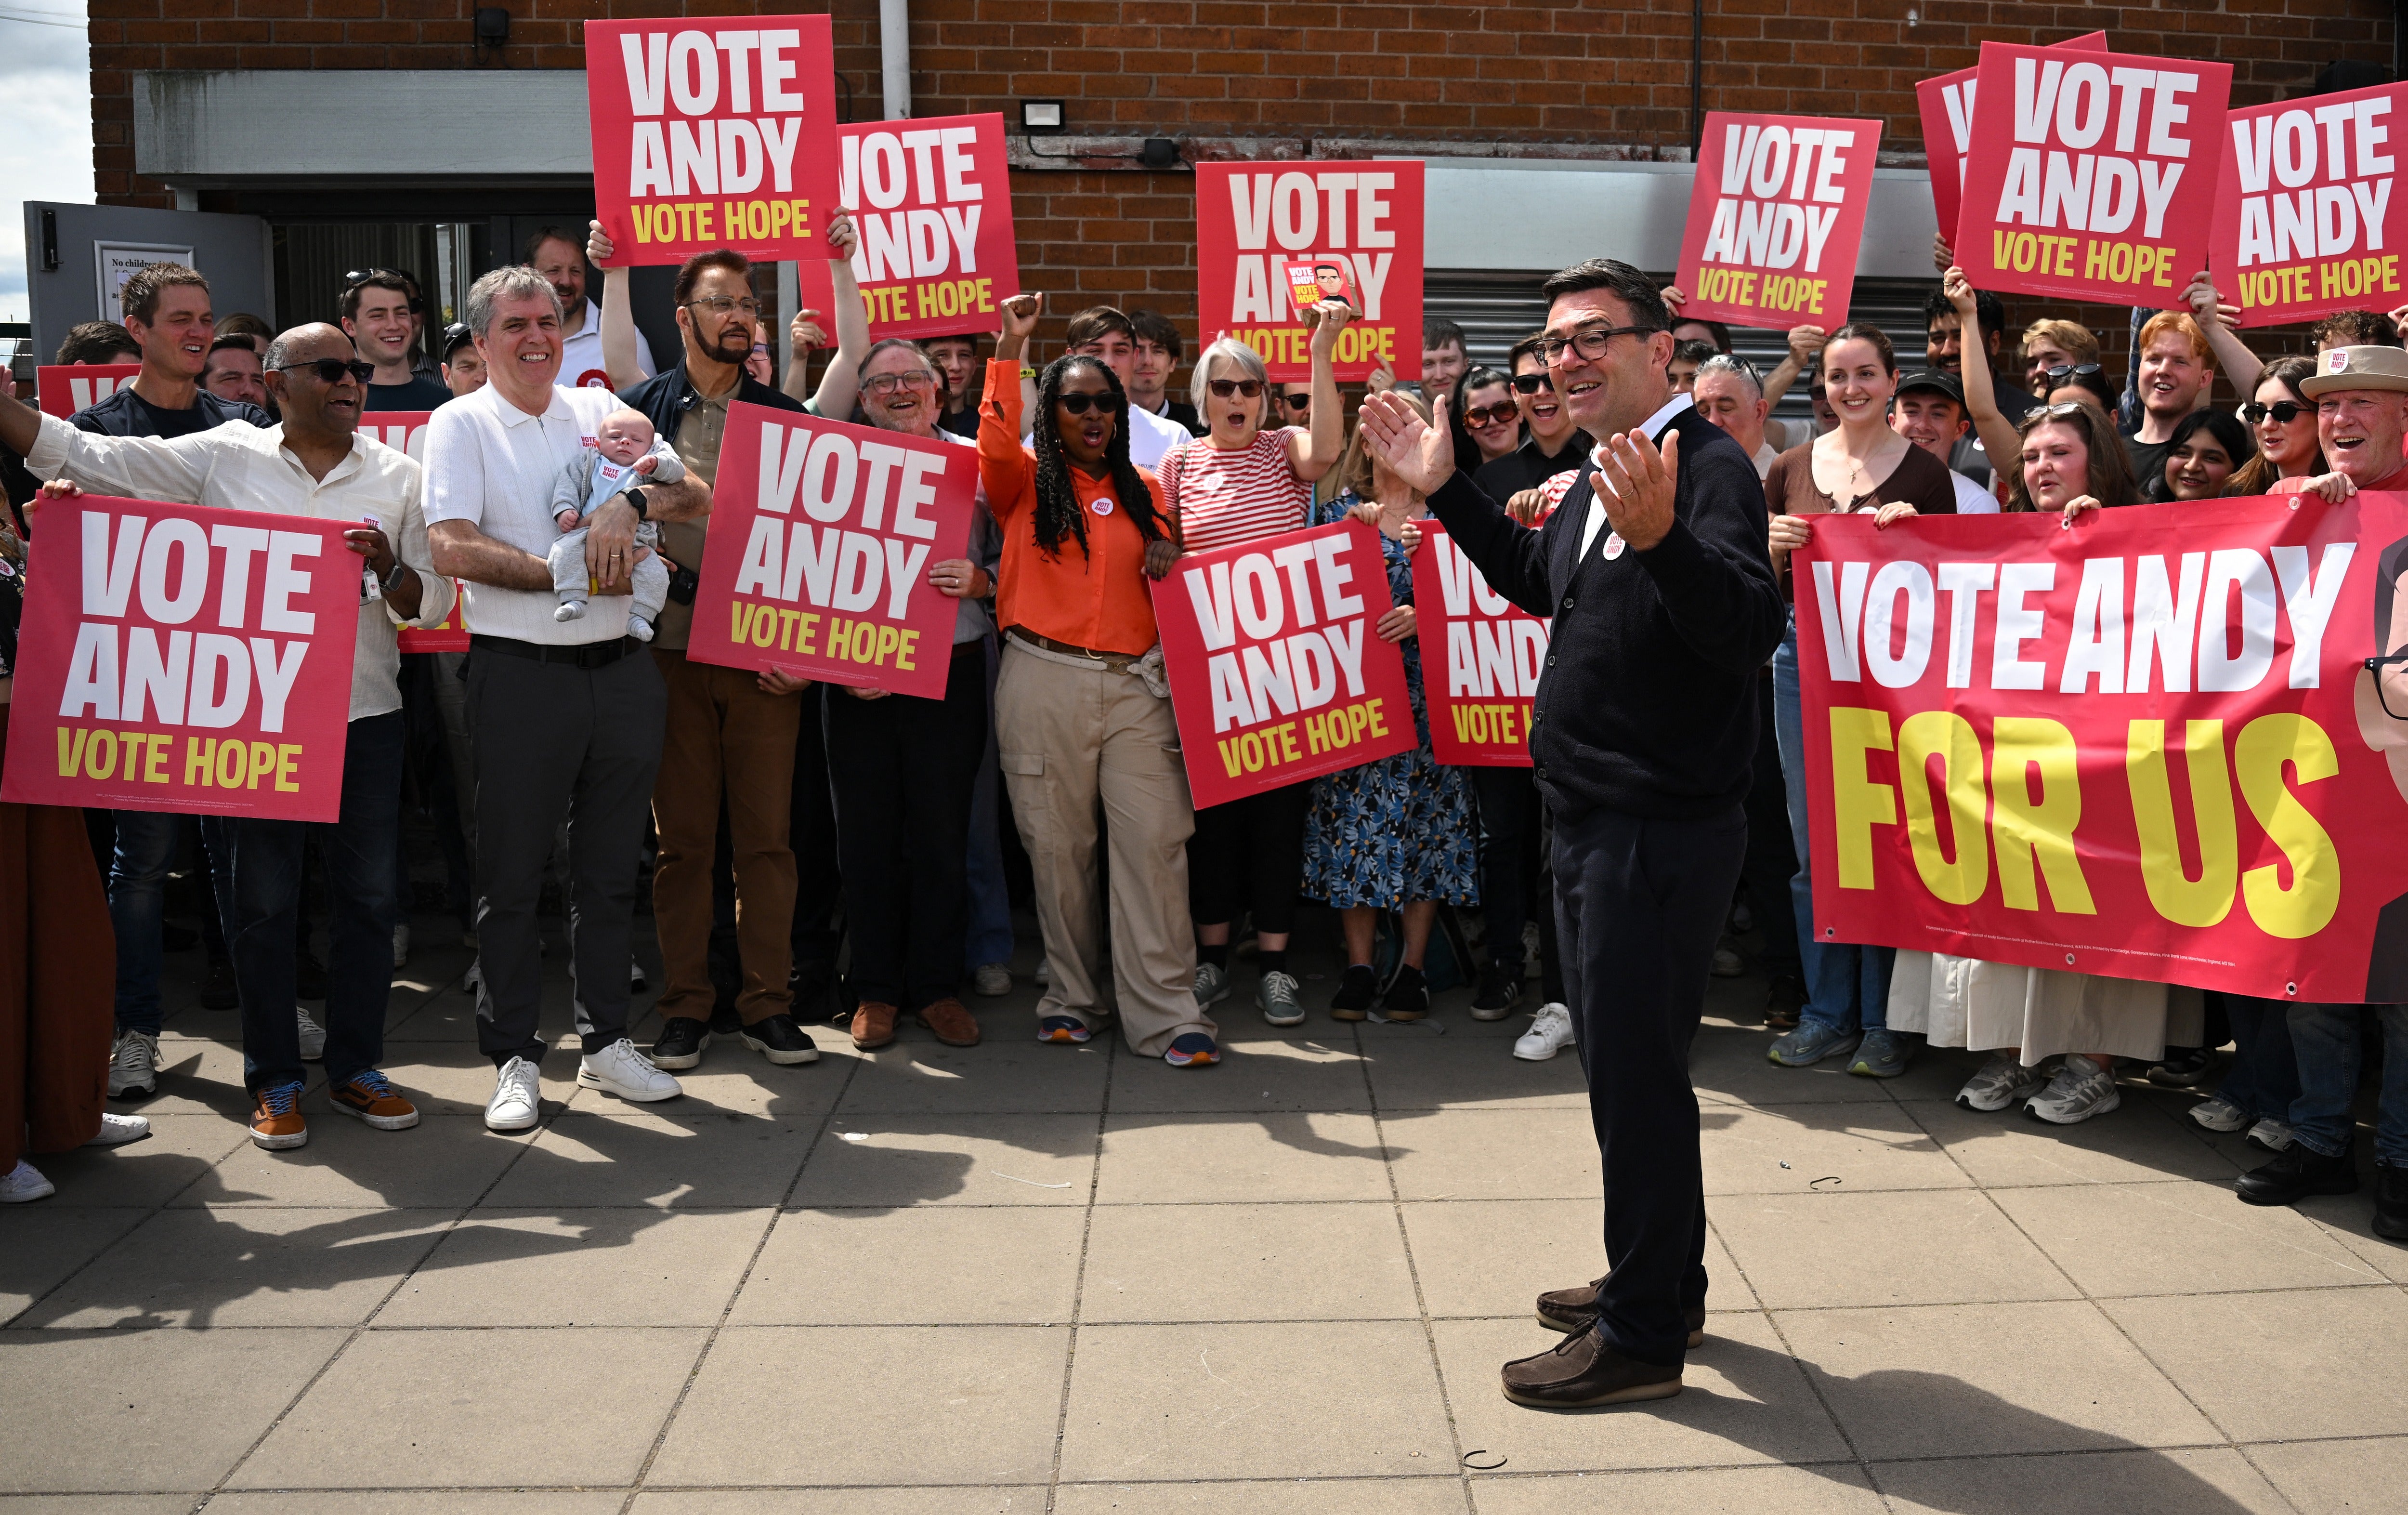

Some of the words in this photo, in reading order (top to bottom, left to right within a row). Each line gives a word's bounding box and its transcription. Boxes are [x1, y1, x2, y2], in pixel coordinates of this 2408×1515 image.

[620, 29, 804, 116] VOTE
[2015, 53, 2199, 158] VOTE
[630, 117, 802, 197] ANDY
[1721, 124, 1855, 203] VOTE
[2232, 95, 2395, 193] VOTE
[630, 202, 716, 244] VOTE
[725, 199, 811, 240] HOPE
[1229, 172, 1395, 250] VOTE
[1995, 148, 2185, 239] ANDY
[2237, 177, 2394, 266] ANDY
[112, 259, 123, 267] No
[1701, 198, 1840, 273] ANDY
[1993, 230, 2078, 277] VOTE
[2084, 239, 2176, 288] HOPE
[917, 278, 995, 319] HOPE
[1288, 267, 1314, 277] VOTE
[1292, 276, 1315, 285] ANDY
[1294, 285, 1319, 295] VOTE
[1296, 294, 1321, 304] HOPE
[1697, 267, 1758, 308] VOTE
[1760, 275, 1827, 315] HOPE
[2238, 266, 2313, 308] VOTE
[2320, 255, 2400, 300] HOPE
[2333, 353, 2345, 361] VOTE
[602, 471, 617, 479] ANDY
[604, 466, 619, 475] VOTE
[758, 421, 947, 540] VOTE
[81, 511, 322, 635] VOTE
[734, 515, 931, 620] ANDY
[1606, 545, 1622, 553] ANDY
[1610, 536, 1623, 545] VOTE
[1183, 531, 1364, 652] VOTE
[1811, 561, 2056, 690] VOTE
[2059, 542, 2357, 695] ANDY
[732, 601, 821, 655] VOTE
[826, 617, 920, 671] HOPE
[59, 622, 310, 733] ANDY
[1208, 619, 1365, 734] ANDY
[57, 727, 172, 784] VOTE
[184, 737, 302, 792] HOPE
[1217, 725, 1302, 778] VOTE
[1307, 698, 1389, 754] HOPE
[1451, 704, 1518, 744] VOTE
[1829, 706, 2097, 915] FOR
[2126, 712, 2341, 939] US
